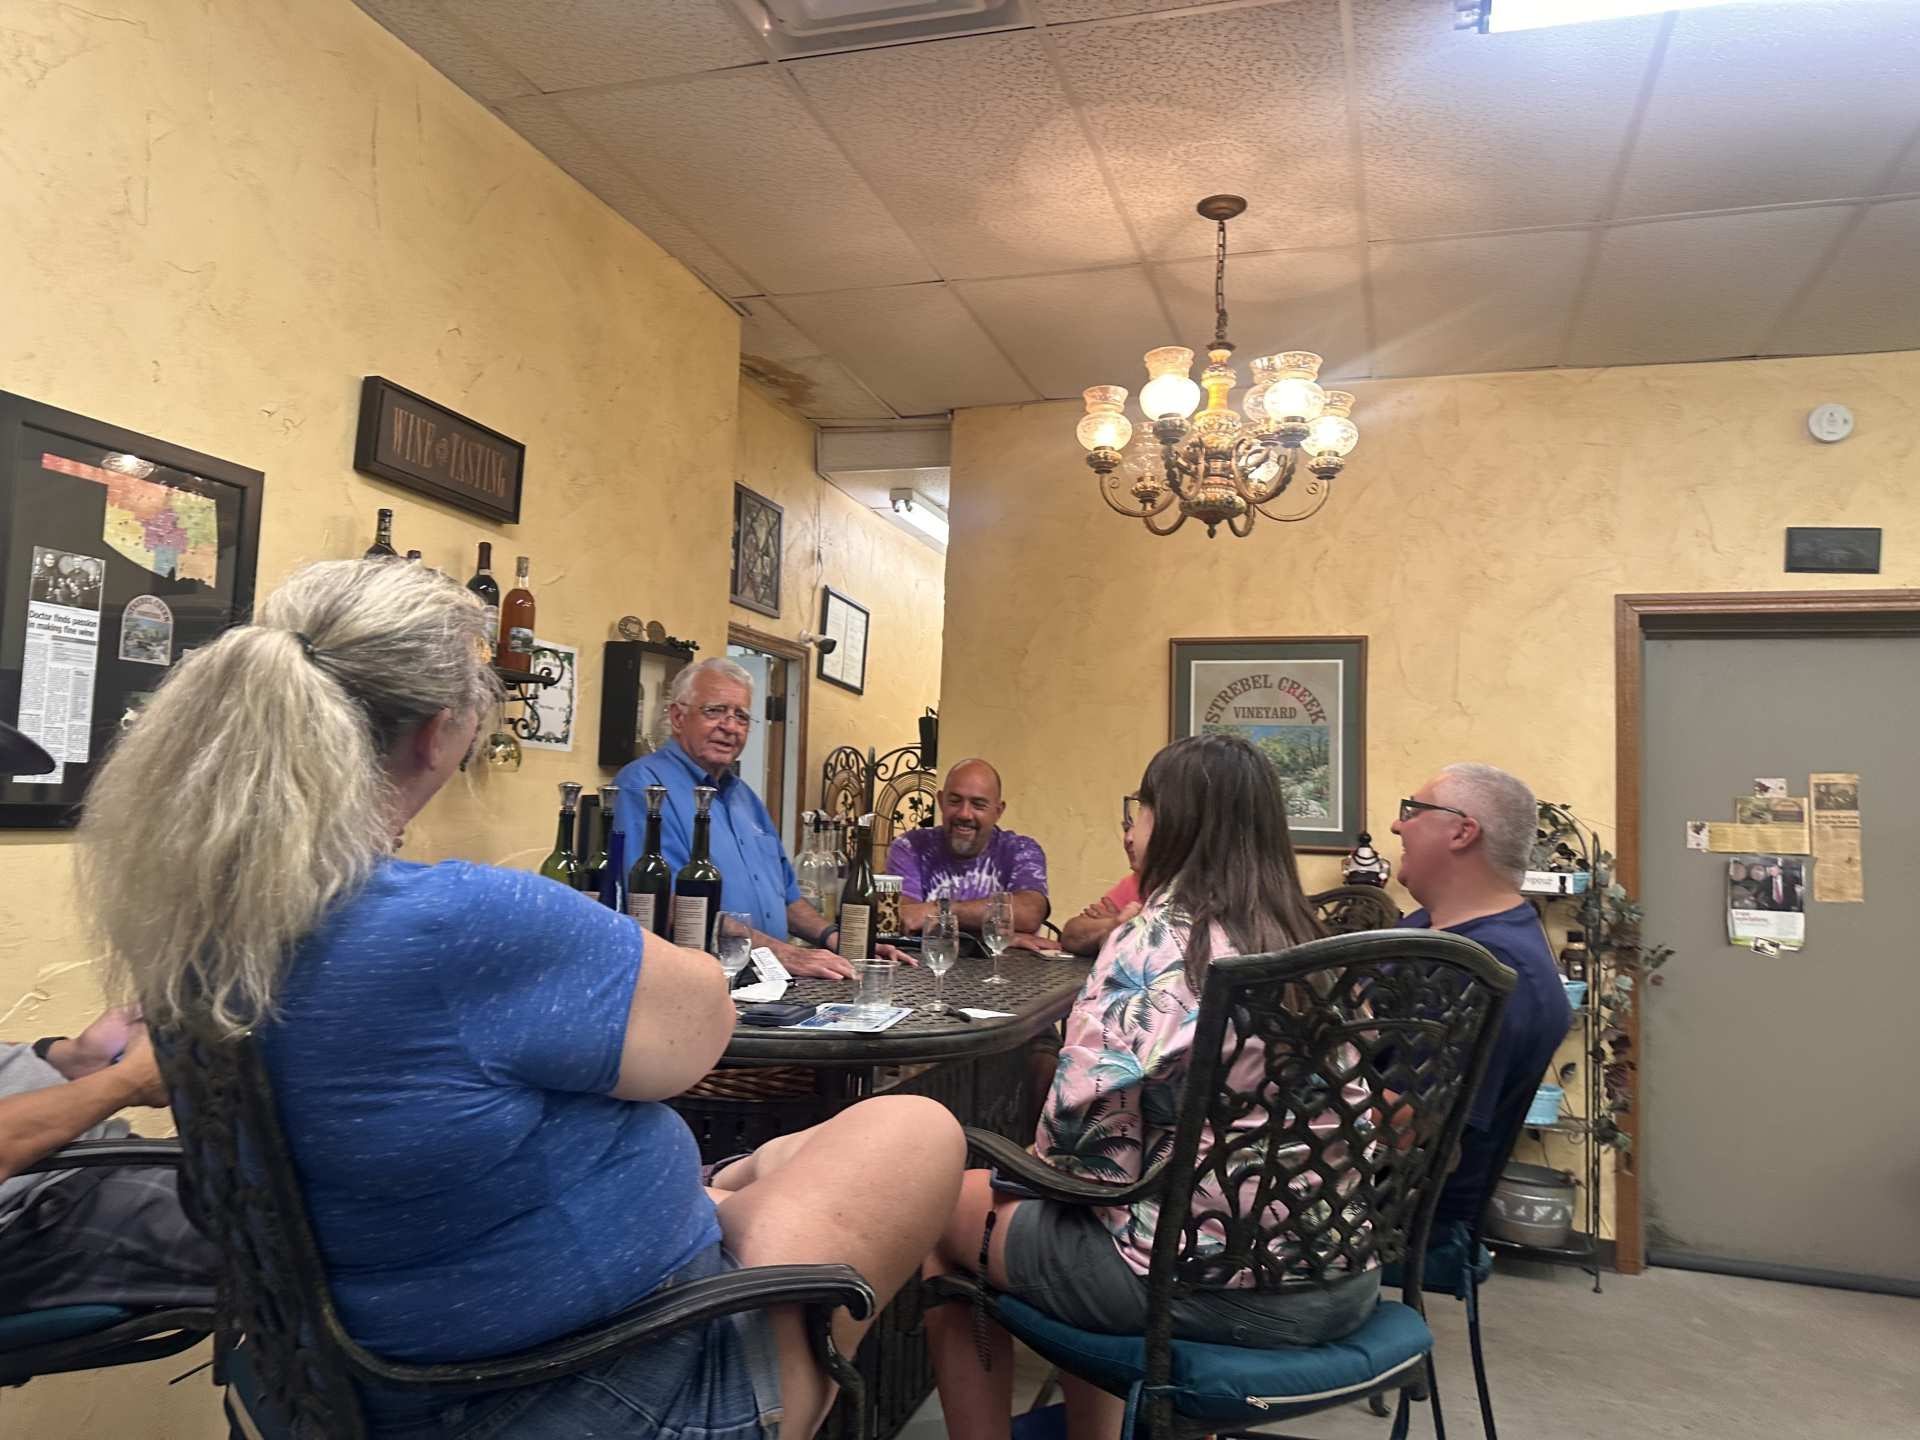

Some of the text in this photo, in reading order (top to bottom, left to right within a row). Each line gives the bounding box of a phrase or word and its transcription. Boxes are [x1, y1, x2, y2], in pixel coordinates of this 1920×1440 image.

[393, 407, 436, 468] WINE
[1204, 674, 1327, 724] STREBEL CREEK
[1233, 706, 1297, 719] VINEYARD
